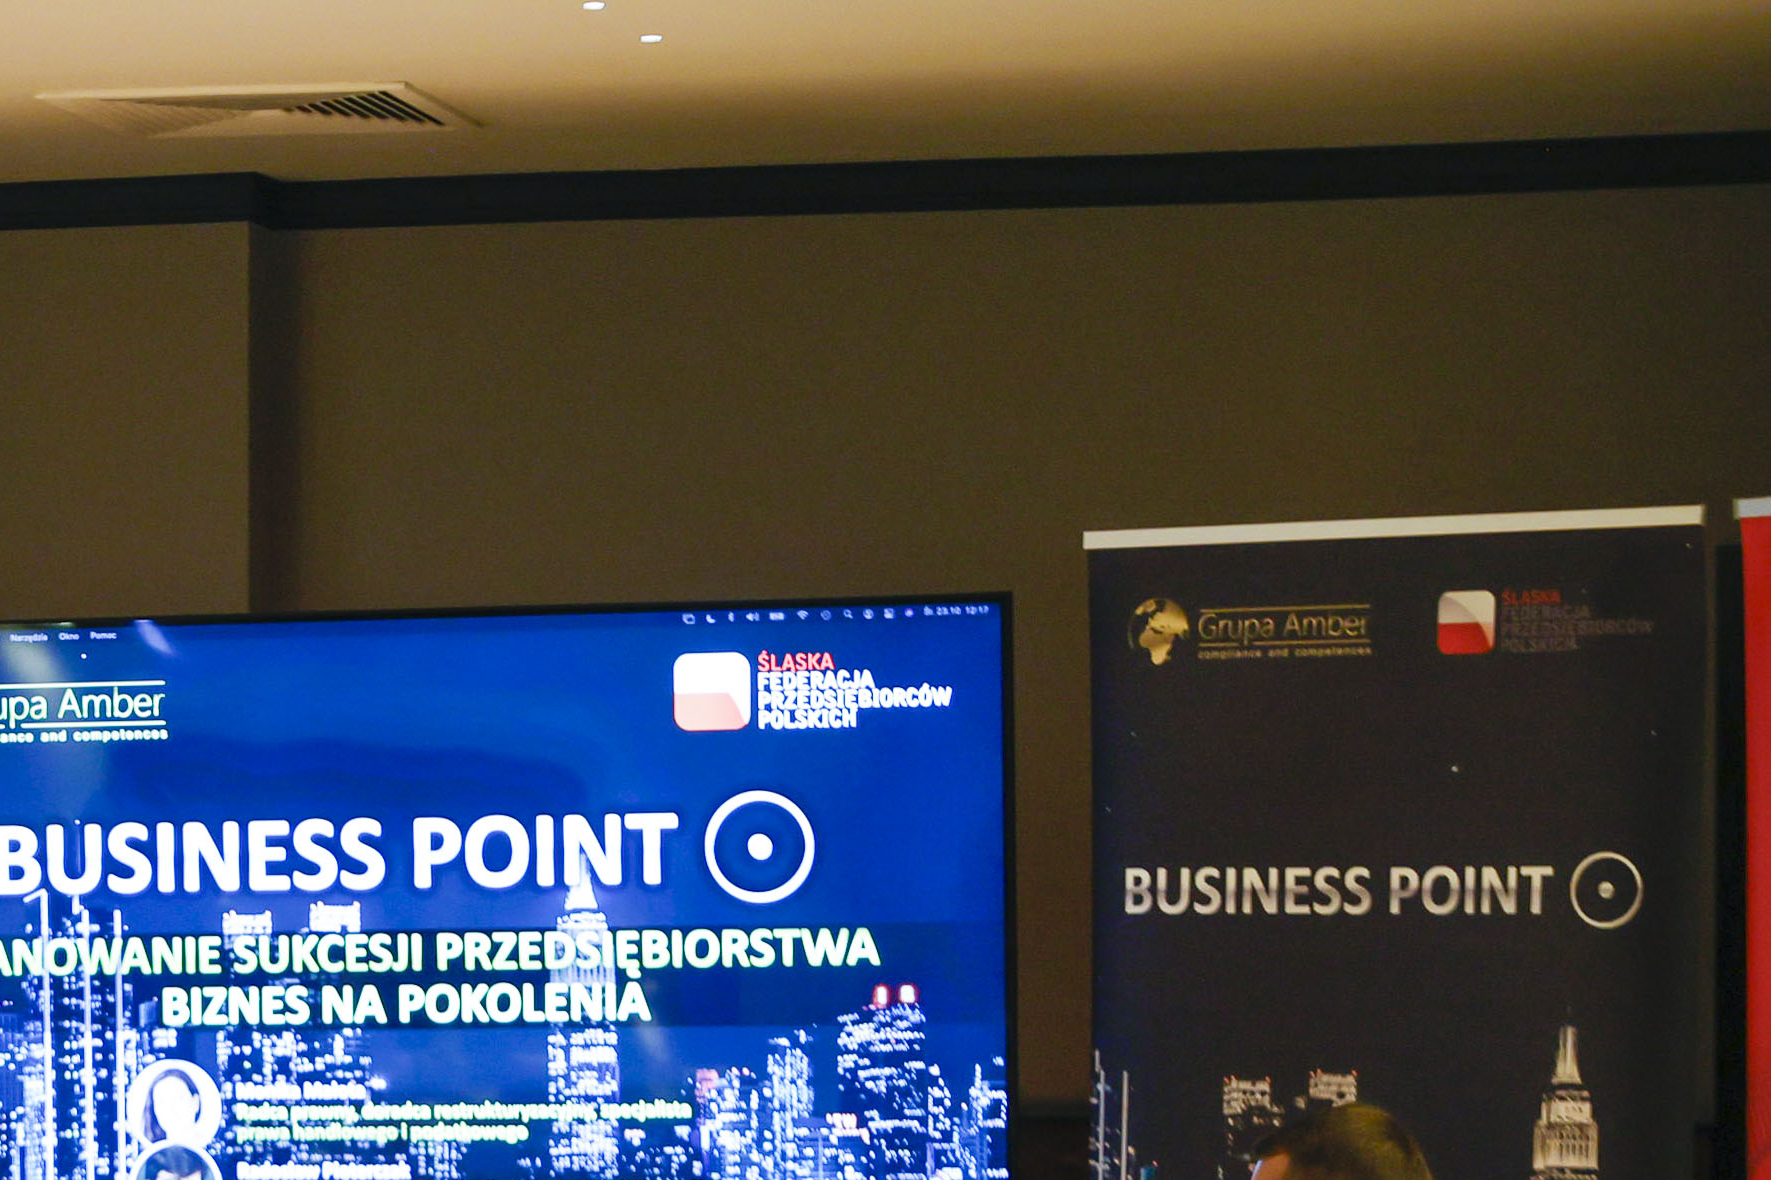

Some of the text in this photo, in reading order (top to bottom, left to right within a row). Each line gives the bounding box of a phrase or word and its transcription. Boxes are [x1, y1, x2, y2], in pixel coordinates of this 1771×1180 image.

[58, 631, 79, 641] Okno
[90, 631, 117, 640] Pomoc
[1198, 612, 1368, 646] Grupa Amber
[757, 650, 836, 673] ŚLĄSKA
[757, 669, 876, 690] FEDERACJA
[57, 686, 166, 719] Amber
[757, 683, 953, 710] PRZEDSIĘBIORCÓW
[757, 708, 858, 730] POLSKICH
[40, 730, 67, 743] and
[72, 729, 169, 743] competences
[412, 811, 680, 890] POINT
[1123, 865, 1555, 917] BUSINESS POINT
[232, 932, 424, 975] SUKCESJI
[436, 927, 882, 979] PRZEDSIĘBIORSTWA
[161, 980, 653, 1027] BIZNES NA POKOLENIA
